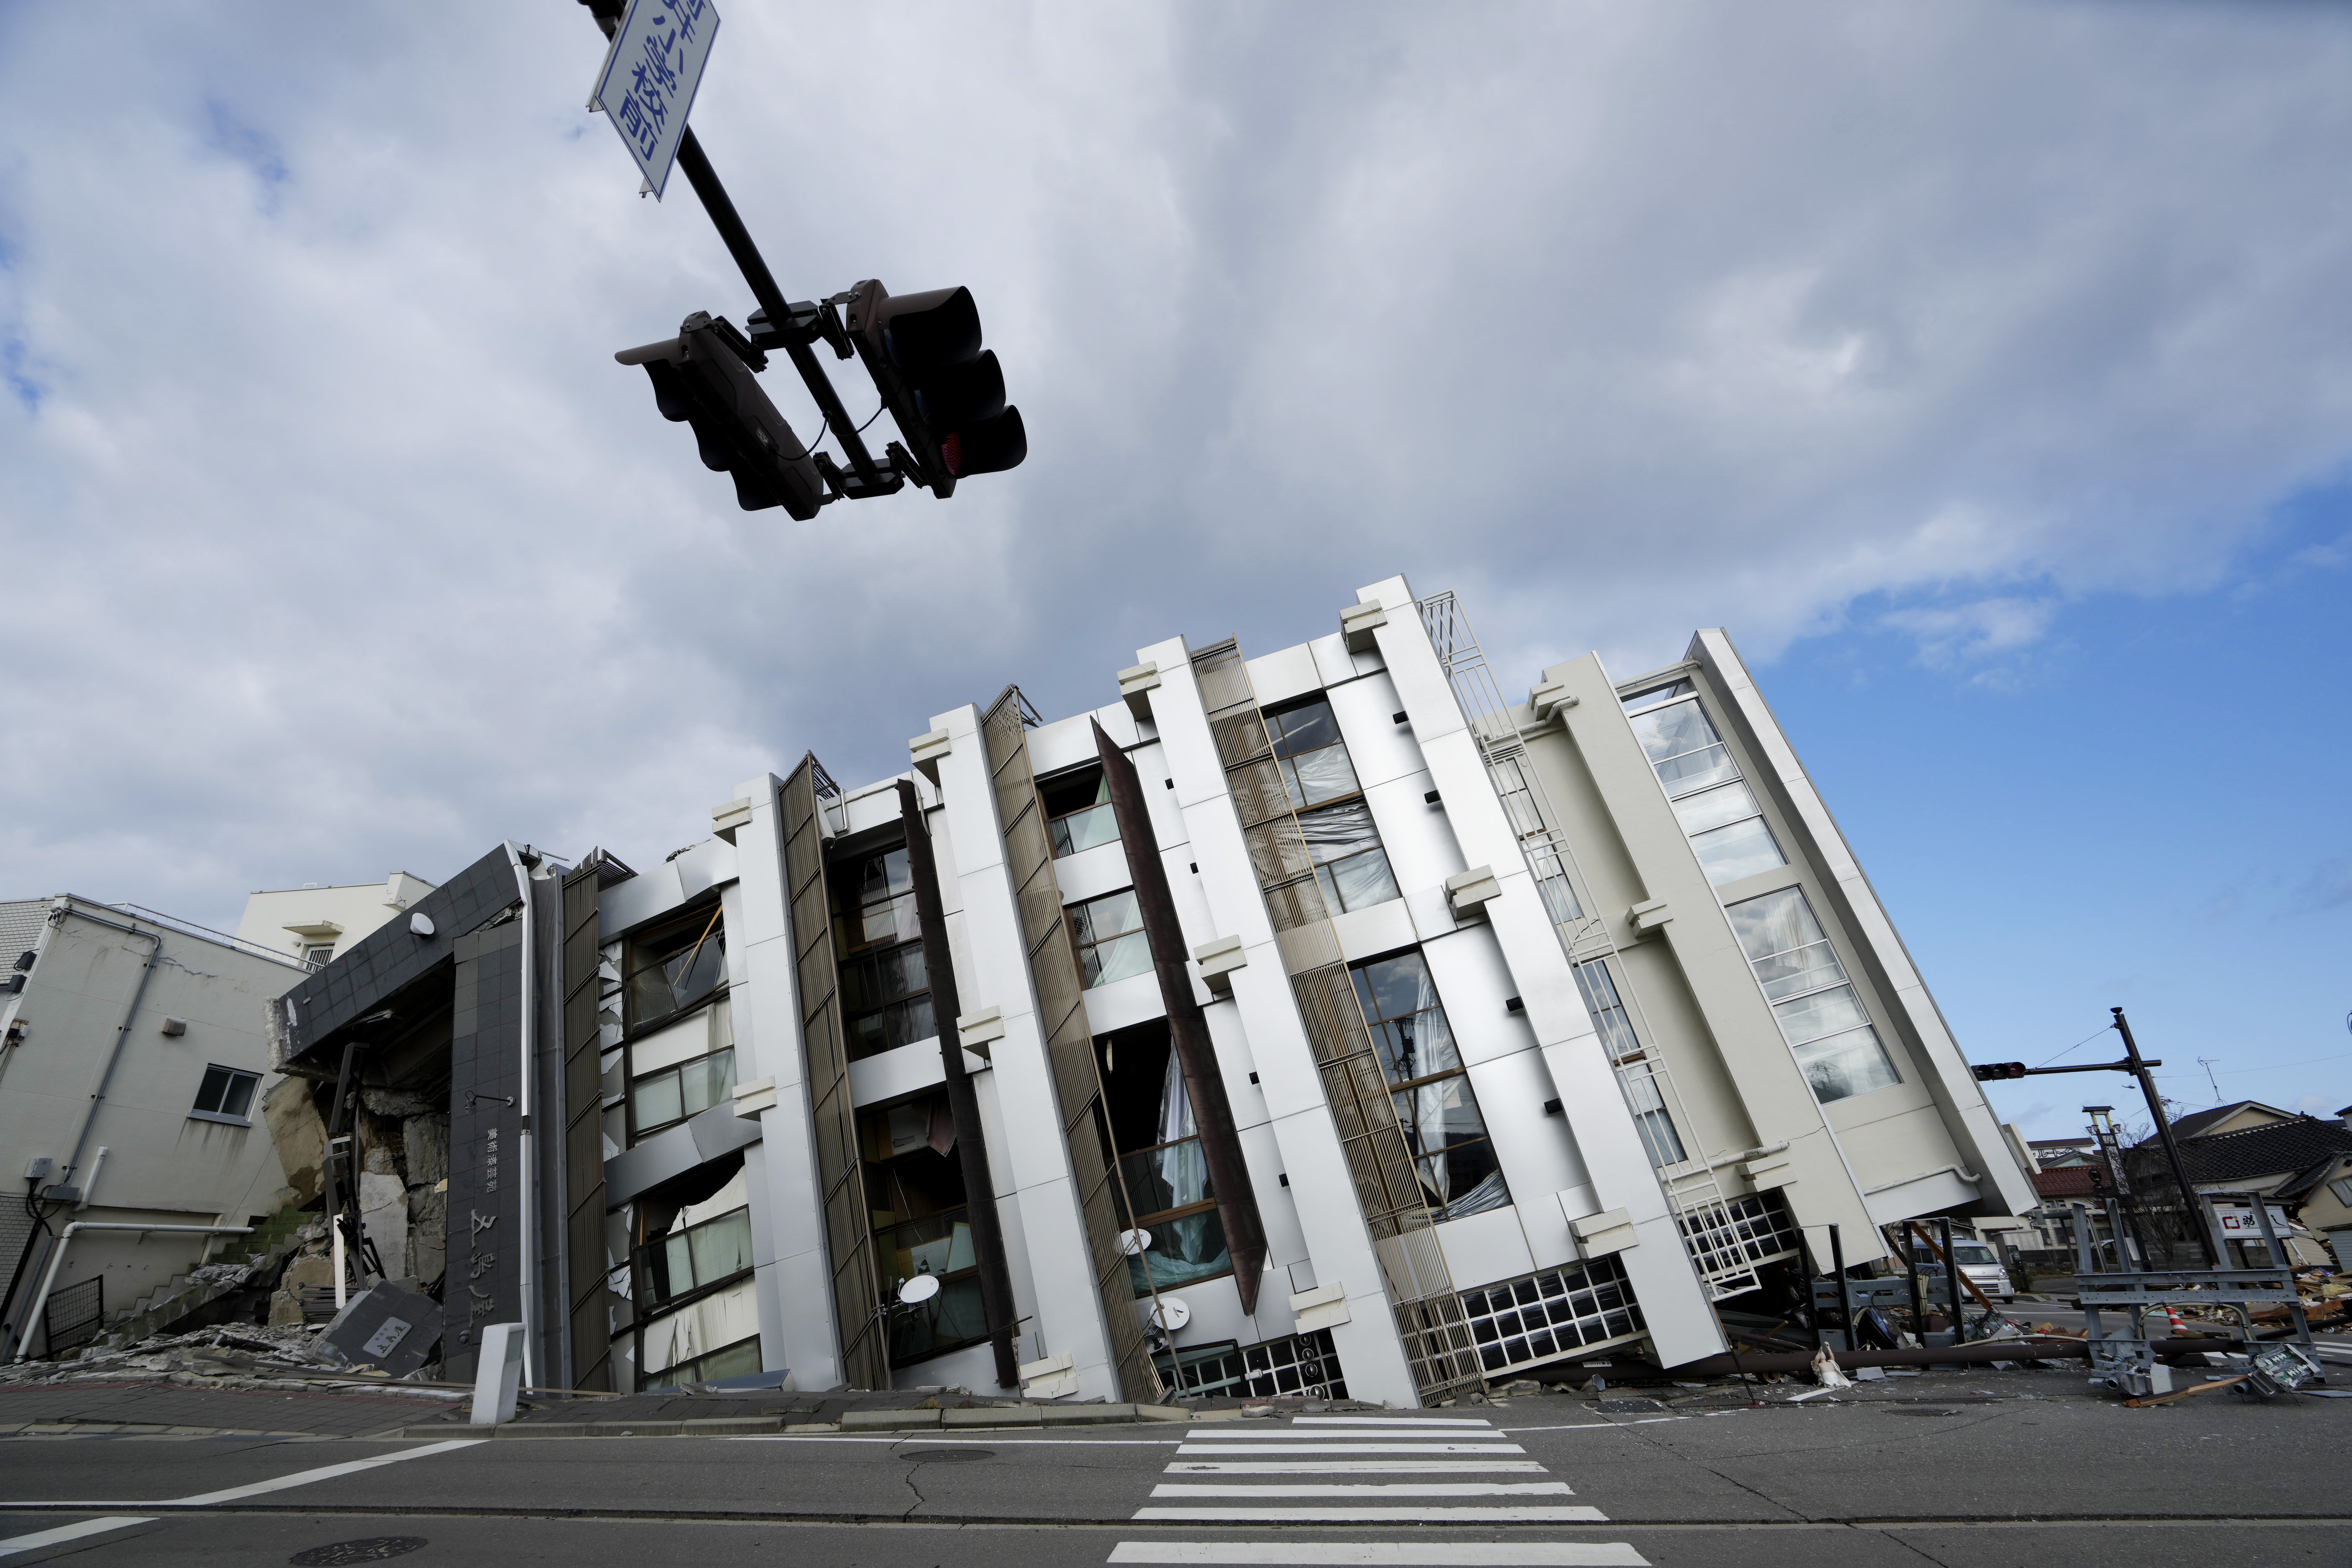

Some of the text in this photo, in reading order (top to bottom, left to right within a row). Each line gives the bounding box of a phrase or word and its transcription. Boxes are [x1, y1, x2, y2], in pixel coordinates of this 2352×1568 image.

[487, 1128, 498, 1193] 美術漆芸苑
